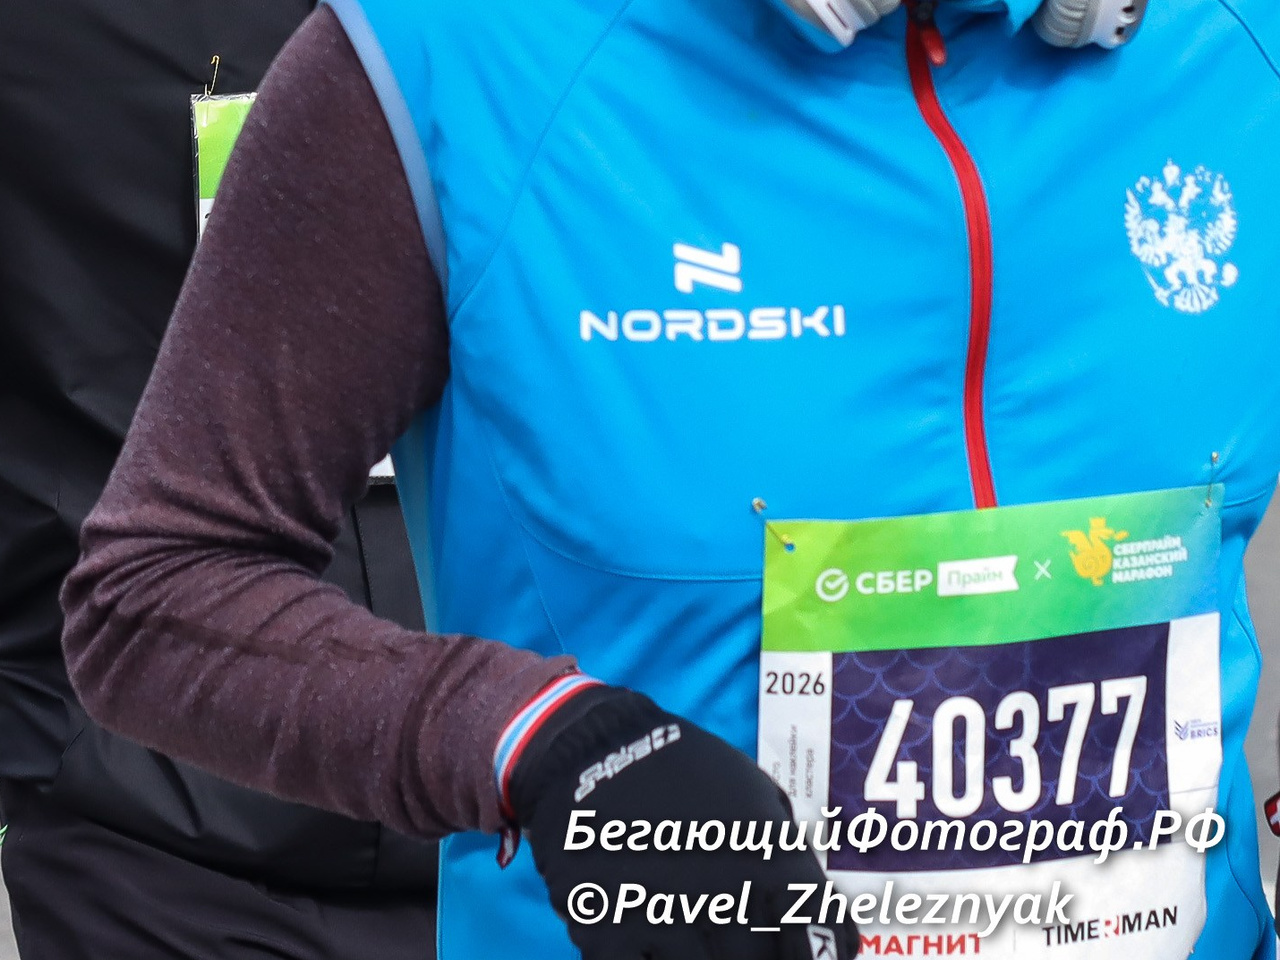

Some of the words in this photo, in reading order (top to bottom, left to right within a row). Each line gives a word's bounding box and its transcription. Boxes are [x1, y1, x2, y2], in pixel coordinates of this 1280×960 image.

[579, 305, 846, 342] NORDSKI
[1113, 546, 1189, 570] КАЗАНСКИЙ
[856, 569, 933, 595] СБЕР
[1112, 565, 1173, 583] МАРАФОН
[766, 671, 825, 695] 2026
[1190, 727, 1219, 739] BRICS
[863, 675, 1148, 820] 40377
[858, 934, 981, 956] МАГНИТ
